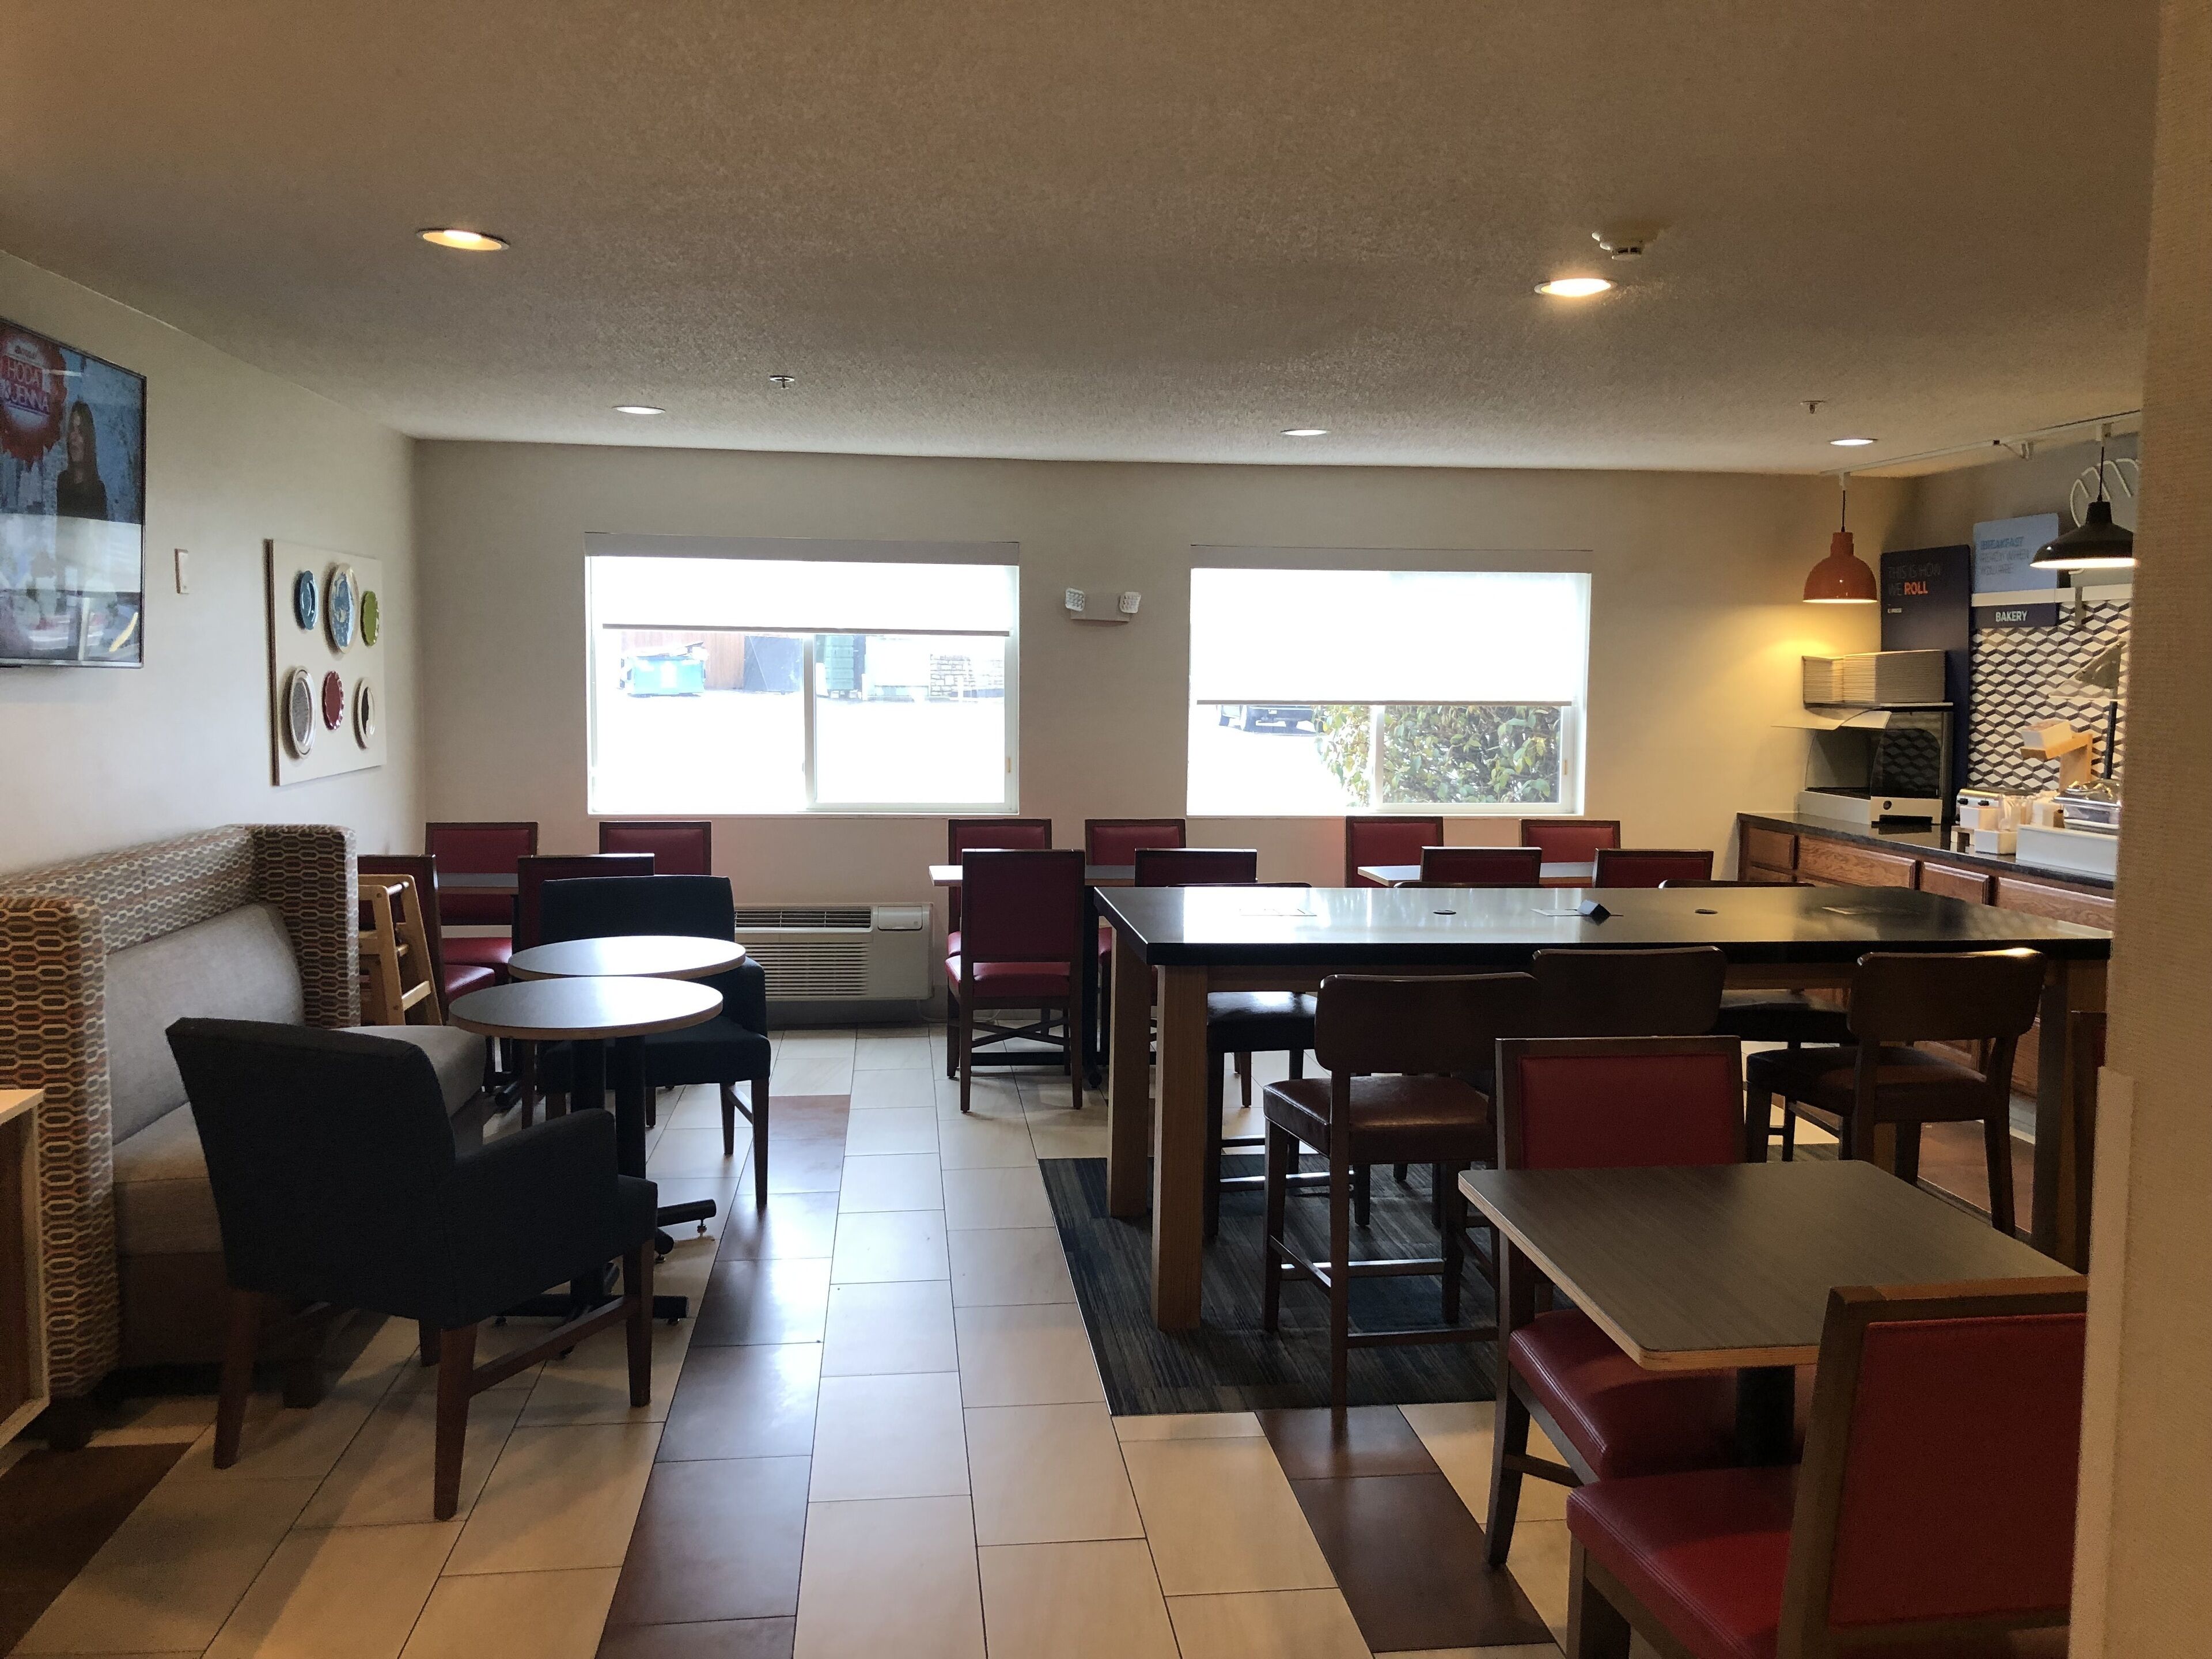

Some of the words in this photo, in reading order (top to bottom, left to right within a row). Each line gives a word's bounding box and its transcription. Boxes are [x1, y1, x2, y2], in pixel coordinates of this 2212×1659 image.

[1980, 536, 2024, 550] BREAKFAST
[1888, 566, 1907, 580] THIS
[1919, 562, 1941, 577] HOW
[1904, 581, 1929, 596] ROLL
[1995, 611, 2028, 623] BAKERY
